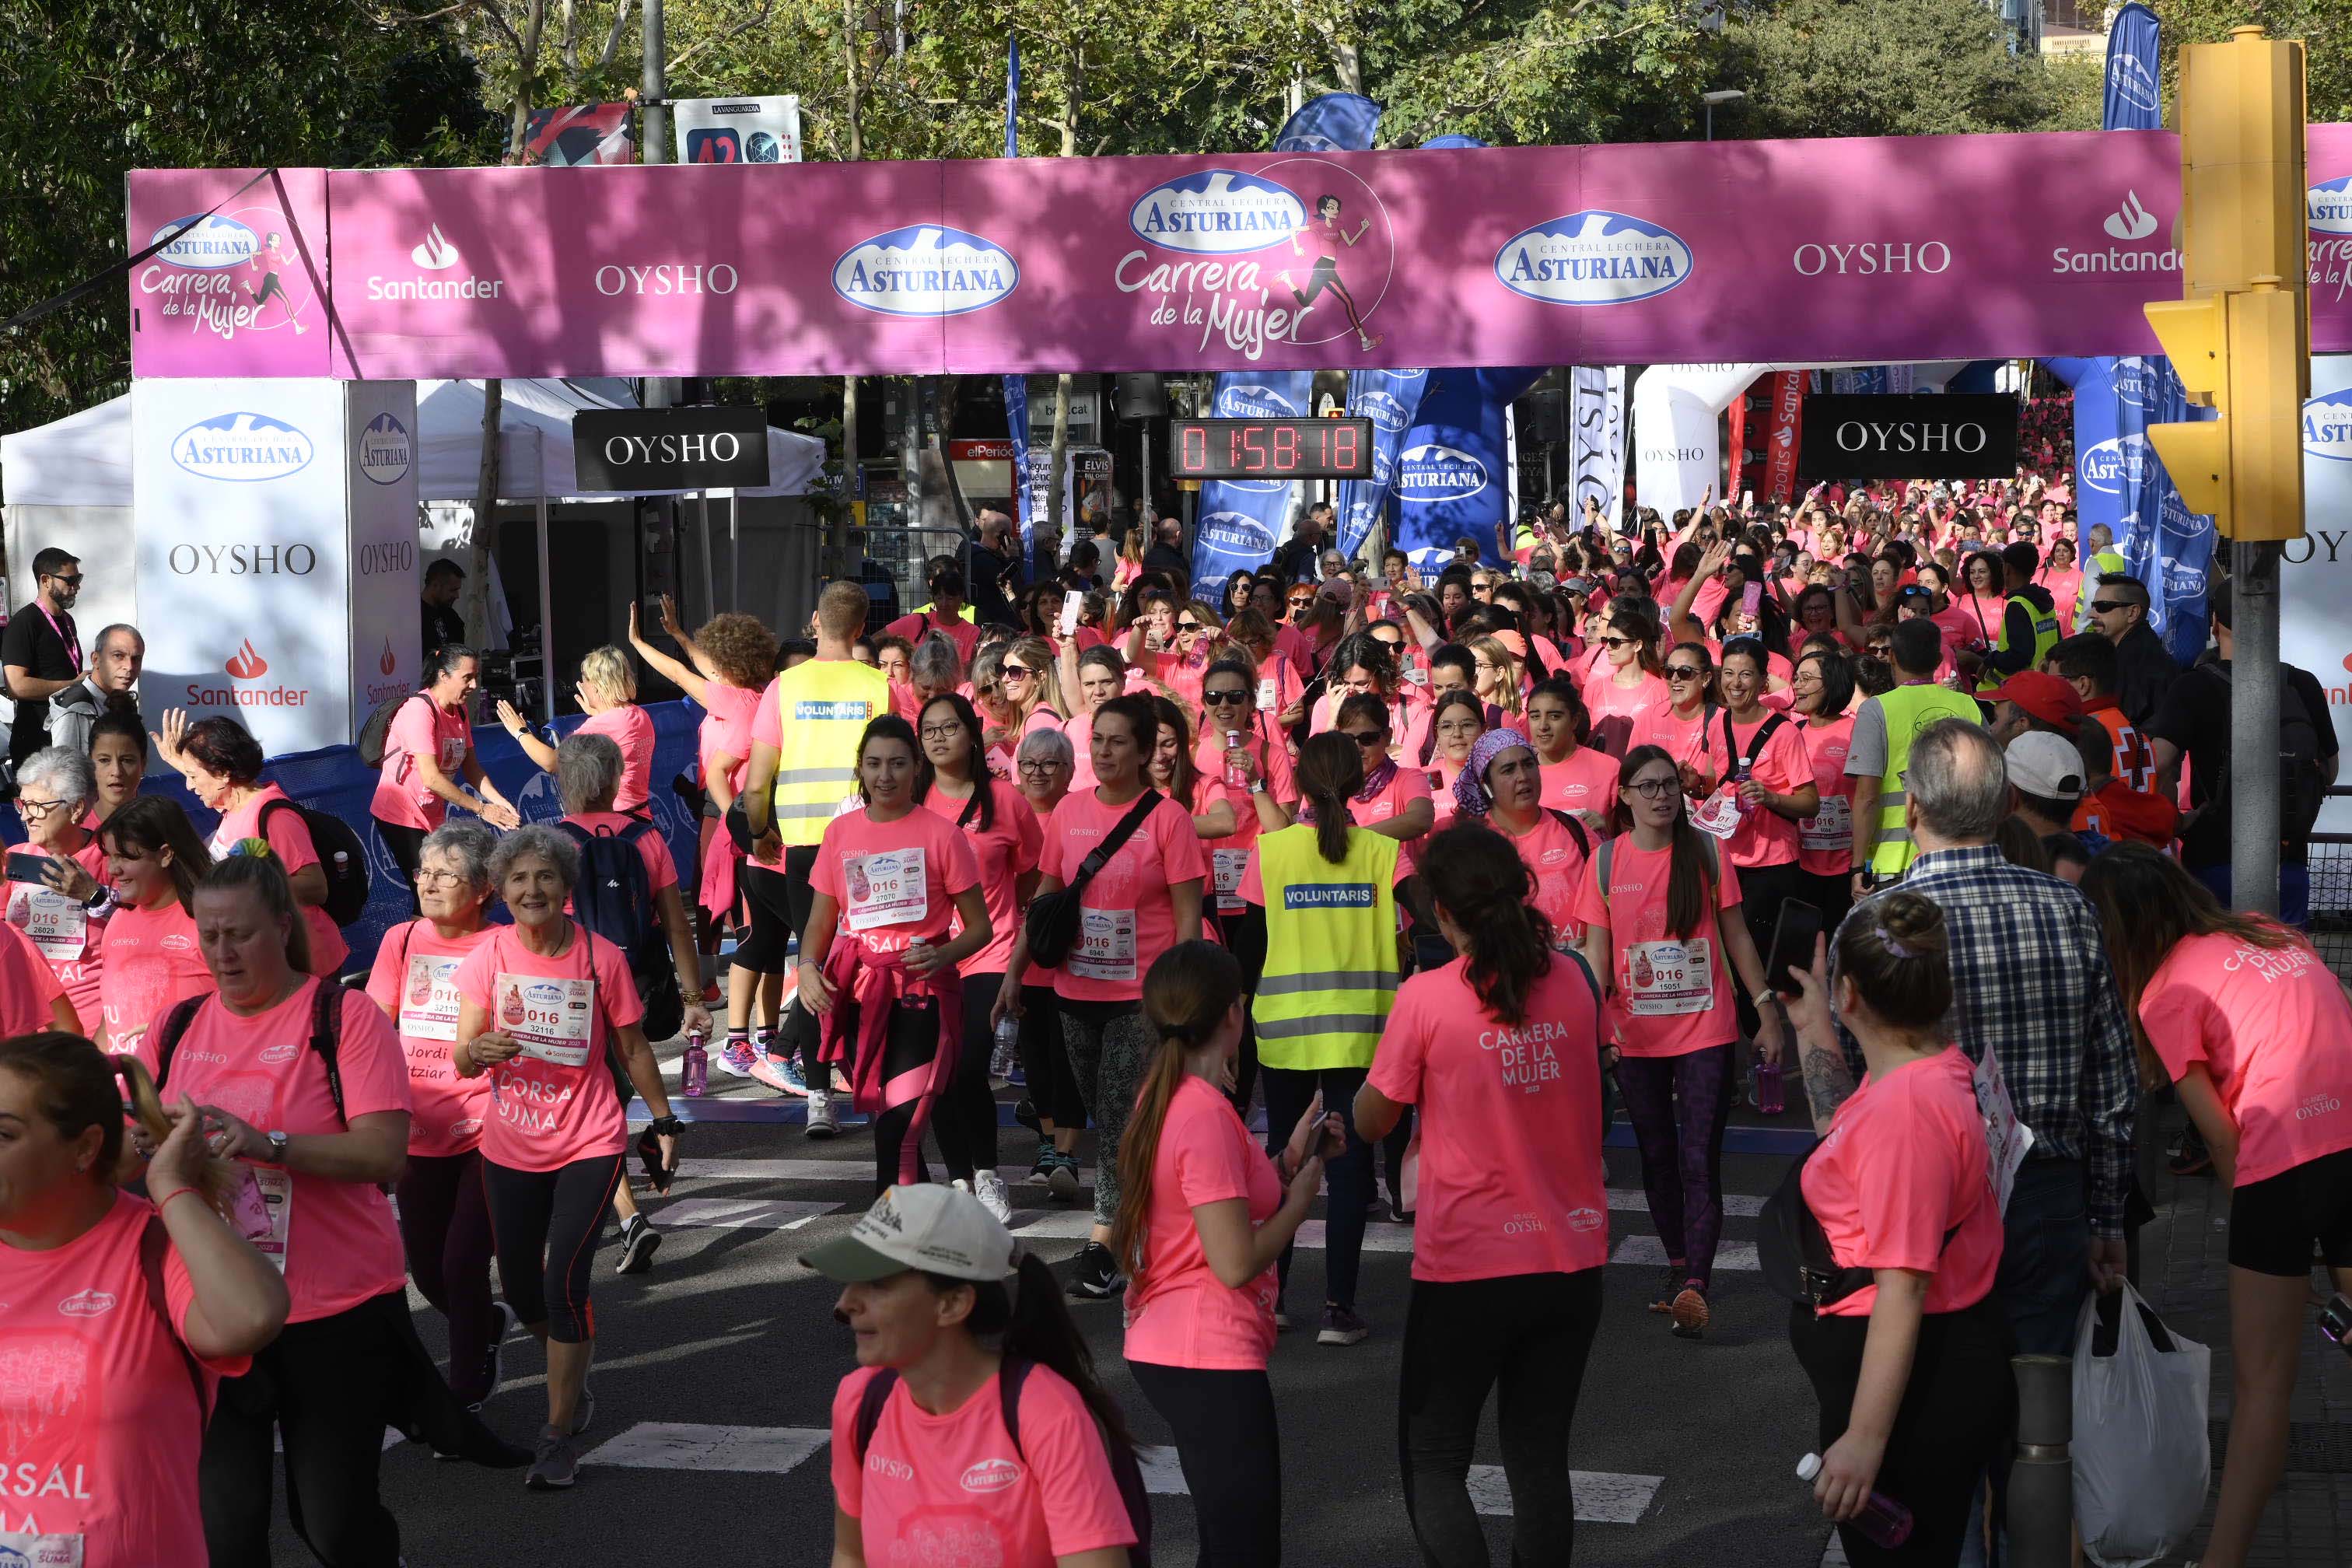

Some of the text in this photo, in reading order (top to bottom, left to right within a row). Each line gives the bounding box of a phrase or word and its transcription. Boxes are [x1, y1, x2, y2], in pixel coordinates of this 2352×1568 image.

[1171, 198, 1288, 208] CENTRAL LECHERA
[1143, 201, 1293, 233] ASTURIANA
[158, 233, 251, 255] ASTURIANA
[1540, 243, 1671, 254] CENTRAL LECHERA
[875, 254, 933, 266] CENTRAL
[1510, 247, 1678, 282] ASTURIANA
[1794, 241, 1952, 275] OYSHO
[140, 265, 231, 294] Carrera
[595, 264, 738, 296] OYSHO
[846, 258, 1006, 292] ASTURIANA
[1115, 250, 1261, 292] Carrera
[368, 275, 503, 300] Santander
[163, 292, 266, 340] de la Mujer
[1150, 286, 1315, 361] de la Mujer
[1836, 421, 1988, 453] OYSHO
[182, 438, 303, 464] ASTURIANA
[362, 439, 408, 467] ASTURIANA
[605, 432, 740, 465] OYSHO
[1645, 447, 1705, 462] OYSHO
[1084, 460, 1109, 471] ELVIS
[1200, 521, 1270, 551] ASTURIANA
[2281, 531, 2352, 563] OY
[169, 544, 317, 575] OYSHO
[360, 541, 412, 575] OYSHO
[187, 684, 308, 707] Santander
[796, 705, 864, 716] VOLUNTARIS
[1069, 828, 1099, 838] OYSHO
[873, 879, 898, 893] 016
[1286, 889, 1370, 903] VOLUNTARIS
[1612, 883, 1643, 894] OYSHO
[876, 893, 895, 903] 27070
[33, 913, 59, 924] 016
[1086, 937, 1110, 948] 016
[2249, 947, 2277, 969] DE
[2259, 950, 2315, 984] MUJER
[1656, 969, 1684, 982] 016
[1660, 982, 1681, 991] 15051
[527, 990, 562, 1001] ASTURIANA
[528, 1010, 559, 1024] 016
[509, 1032, 531, 1041] ARRERA
[548, 1038, 567, 1046] MUJER
[530, 1024, 555, 1035] 32116
[1479, 1020, 1569, 1050] CARRERA
[180, 1050, 228, 1065] OYSHO
[408, 1045, 447, 1060] Jordi
[552, 1051, 583, 1059] Santander
[1501, 1041, 1556, 1067] DE LA
[1502, 1060, 1562, 1087] MUJER
[2295, 1097, 2341, 1121] OYSHO
[37, 1555, 71, 1564] SUMA
